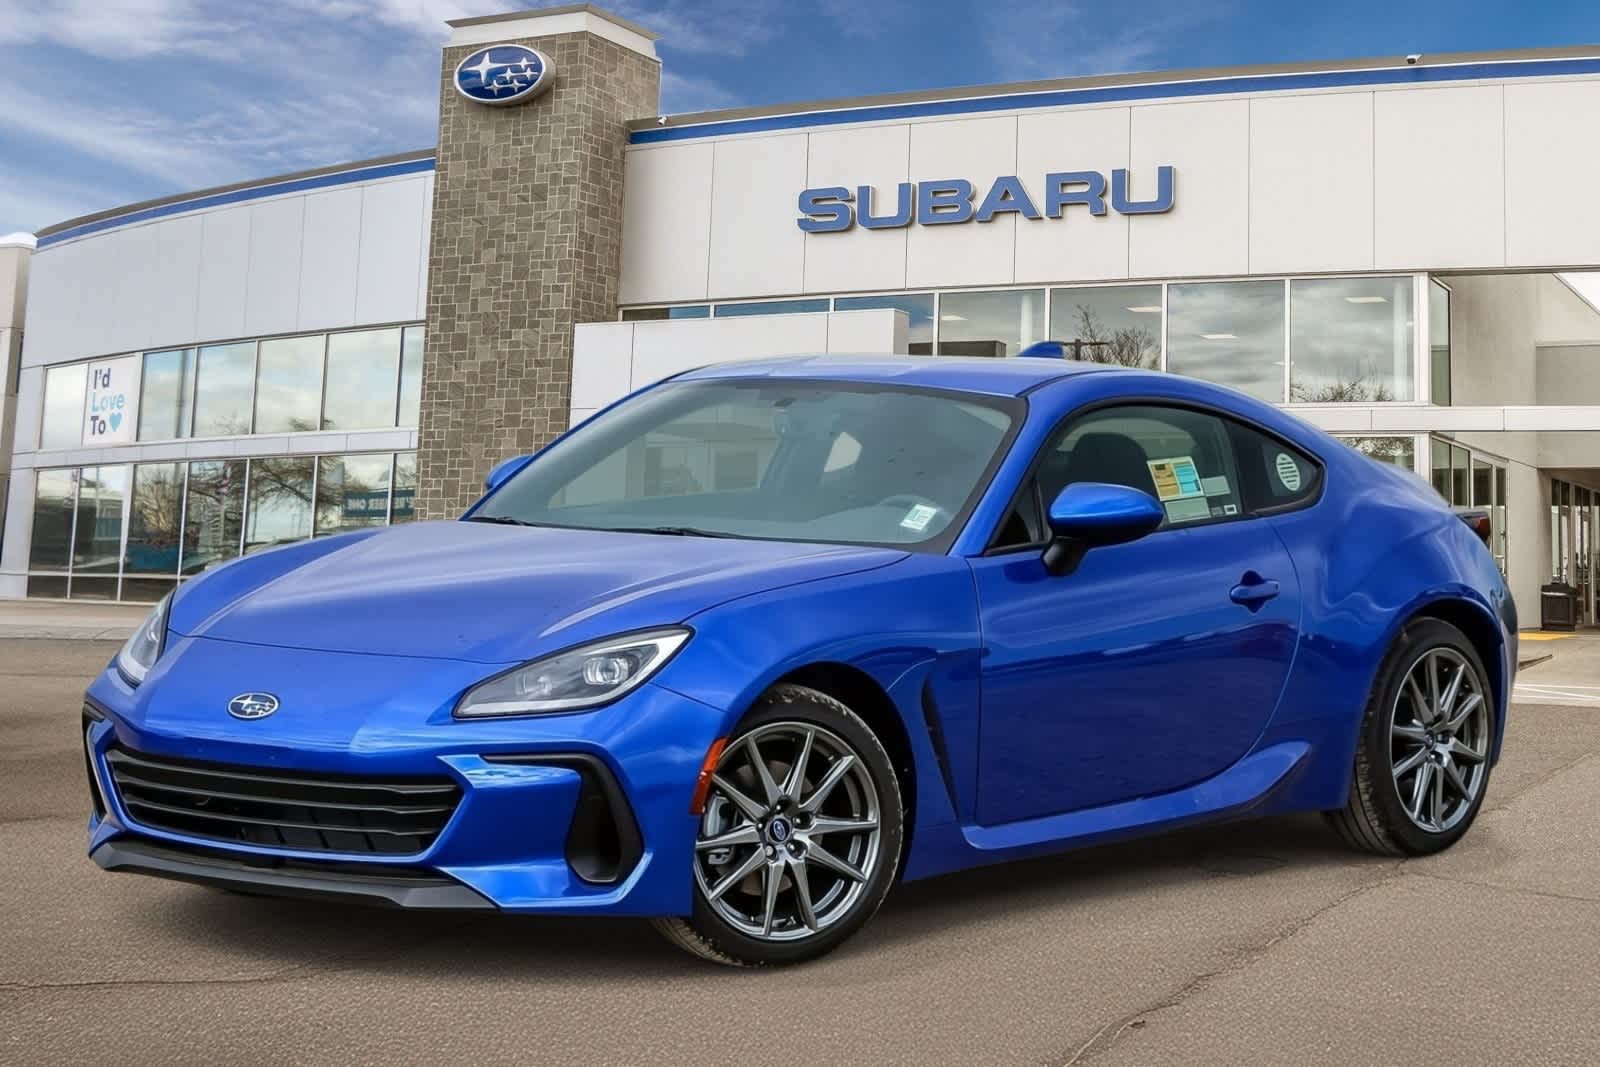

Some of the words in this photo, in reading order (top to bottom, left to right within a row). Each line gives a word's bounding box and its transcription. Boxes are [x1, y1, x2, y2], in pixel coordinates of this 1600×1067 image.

[797, 165, 1177, 234] SUBARU
[93, 367, 111, 390] I'd
[91, 392, 125, 412] Love
[90, 415, 107, 436] To
